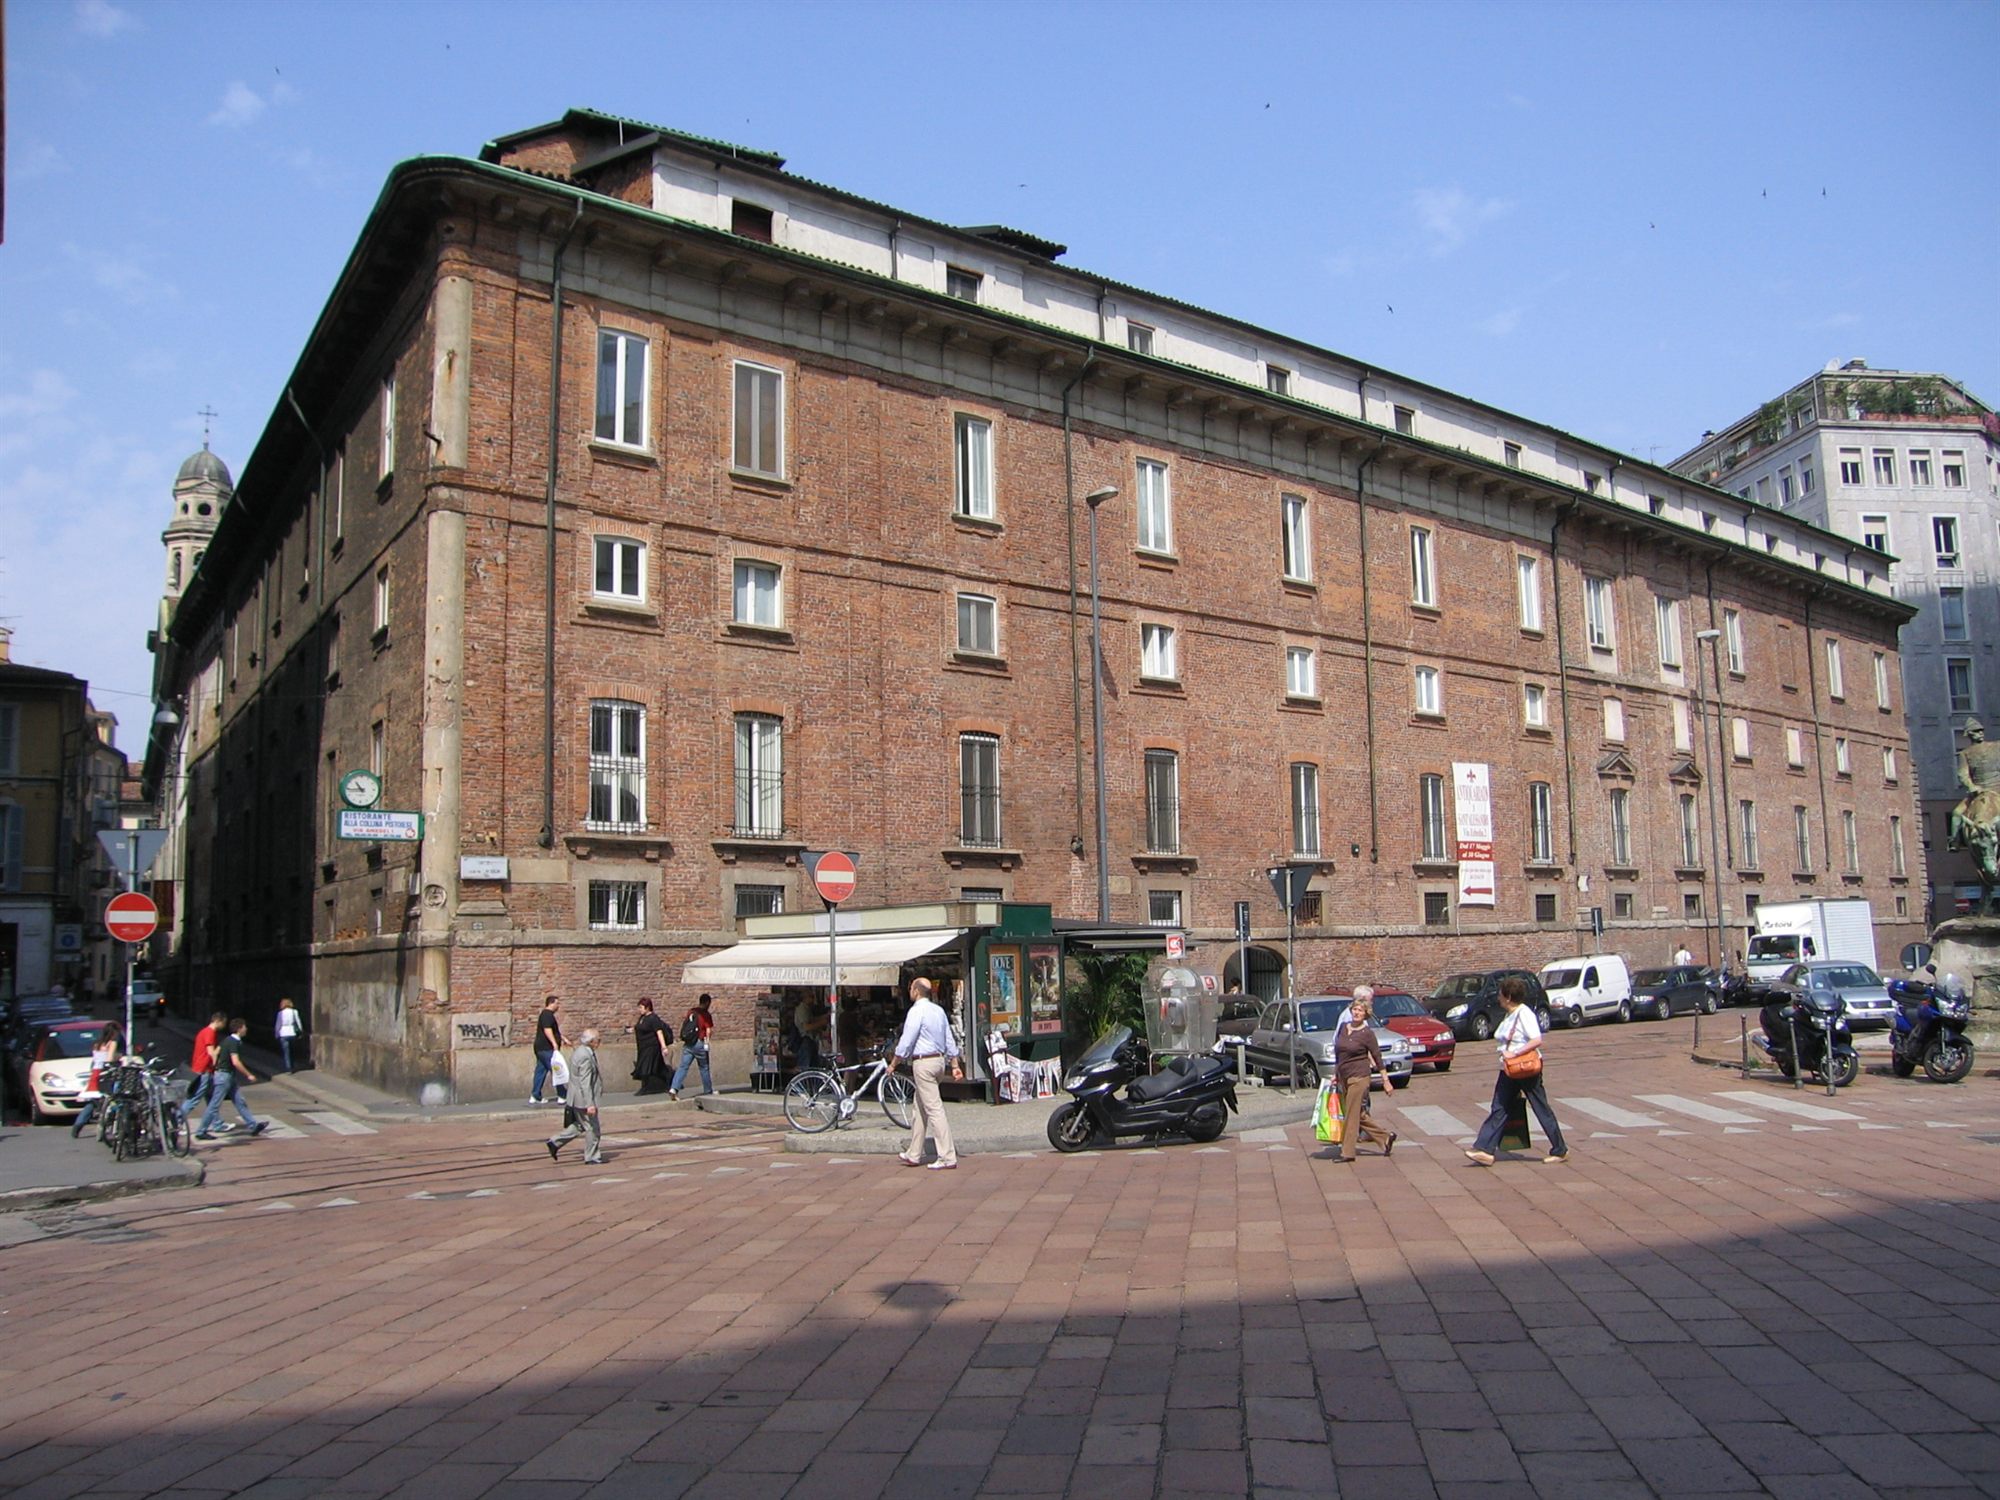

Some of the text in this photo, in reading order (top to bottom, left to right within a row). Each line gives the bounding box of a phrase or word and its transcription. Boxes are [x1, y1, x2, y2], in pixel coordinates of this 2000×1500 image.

[343, 812, 392, 820] RISTORANTE
[1475, 843, 1491, 851] Maggio
[992, 956, 1011, 969] DOVE
